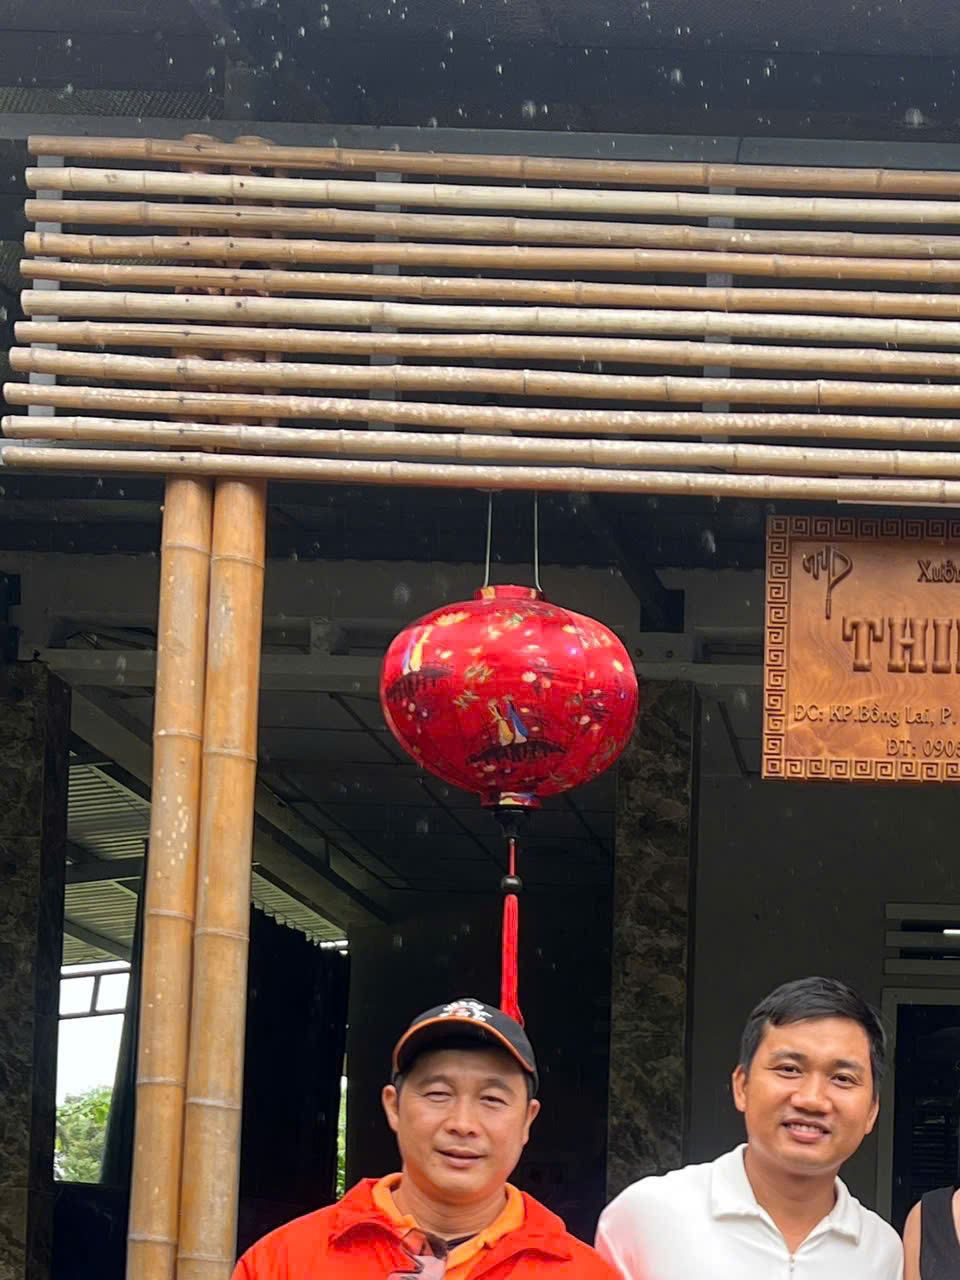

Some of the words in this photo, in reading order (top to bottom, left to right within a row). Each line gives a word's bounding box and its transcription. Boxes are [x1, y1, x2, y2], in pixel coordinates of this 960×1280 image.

[793, 703, 824, 722] ĐC:
[905, 705, 934, 727] Lai,
[940, 706, 957, 726] P.
[886, 737, 917, 758] ĐT:
